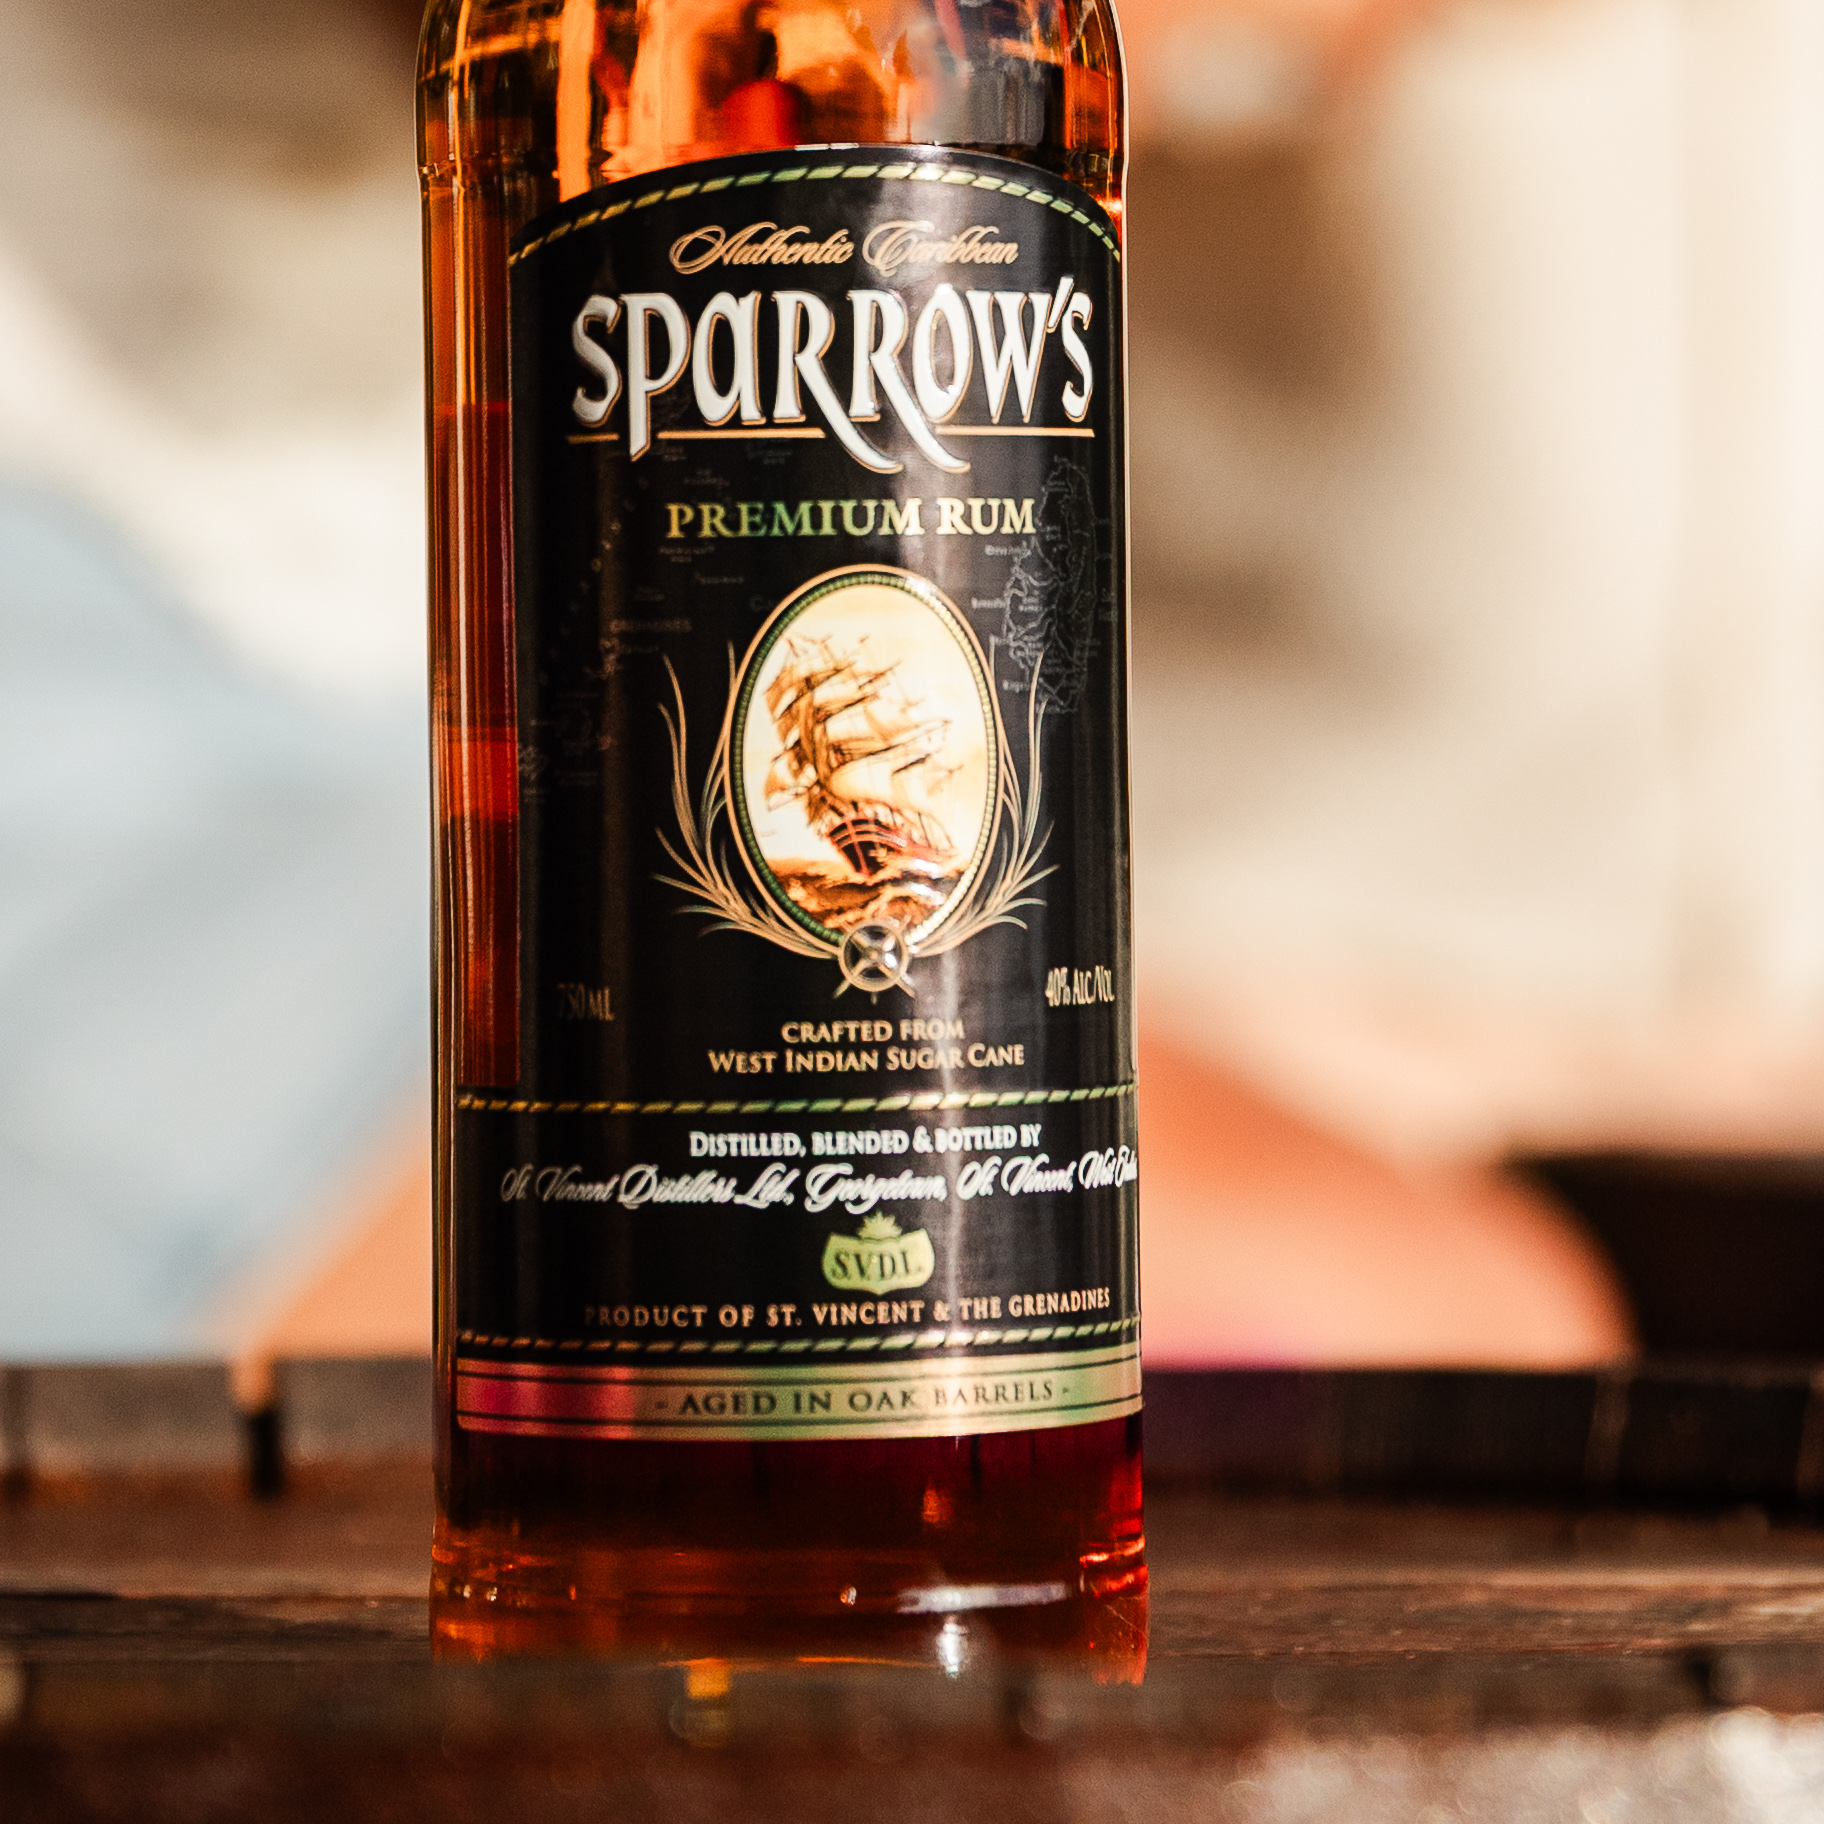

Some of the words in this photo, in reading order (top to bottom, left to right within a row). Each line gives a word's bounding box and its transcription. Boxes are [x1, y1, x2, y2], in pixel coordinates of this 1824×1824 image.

[668, 221, 855, 274] Authentic
[862, 220, 1019, 277] Caribbean
[665, 497, 927, 539] PREMIUM
[934, 496, 1037, 536] RUM
[781, 1020, 893, 1044] CRAFTED
[899, 1018, 966, 1041] FROM
[811, 1129, 910, 1156] BLENDED
[912, 1125, 934, 1154] &
[934, 1123, 1017, 1154] BOTTLED
[1020, 1123, 1042, 1149] BY
[535, 1165, 620, 1202] Vincent
[616, 1163, 738, 1210] Distillers
[585, 1303, 708, 1328] PRODUCT
[718, 1303, 755, 1328] OF
[766, 1303, 803, 1328] ST.
[812, 1299, 925, 1326] VINCENT
[933, 1299, 952, 1323] &
[956, 1296, 1002, 1321] THE
[1008, 1286, 1111, 1318] GRENADINES
[680, 1390, 776, 1418] AGED
[793, 1389, 832, 1415] IN
[848, 1386, 922, 1412] OAK
[934, 1380, 1054, 1408] BARRELS
